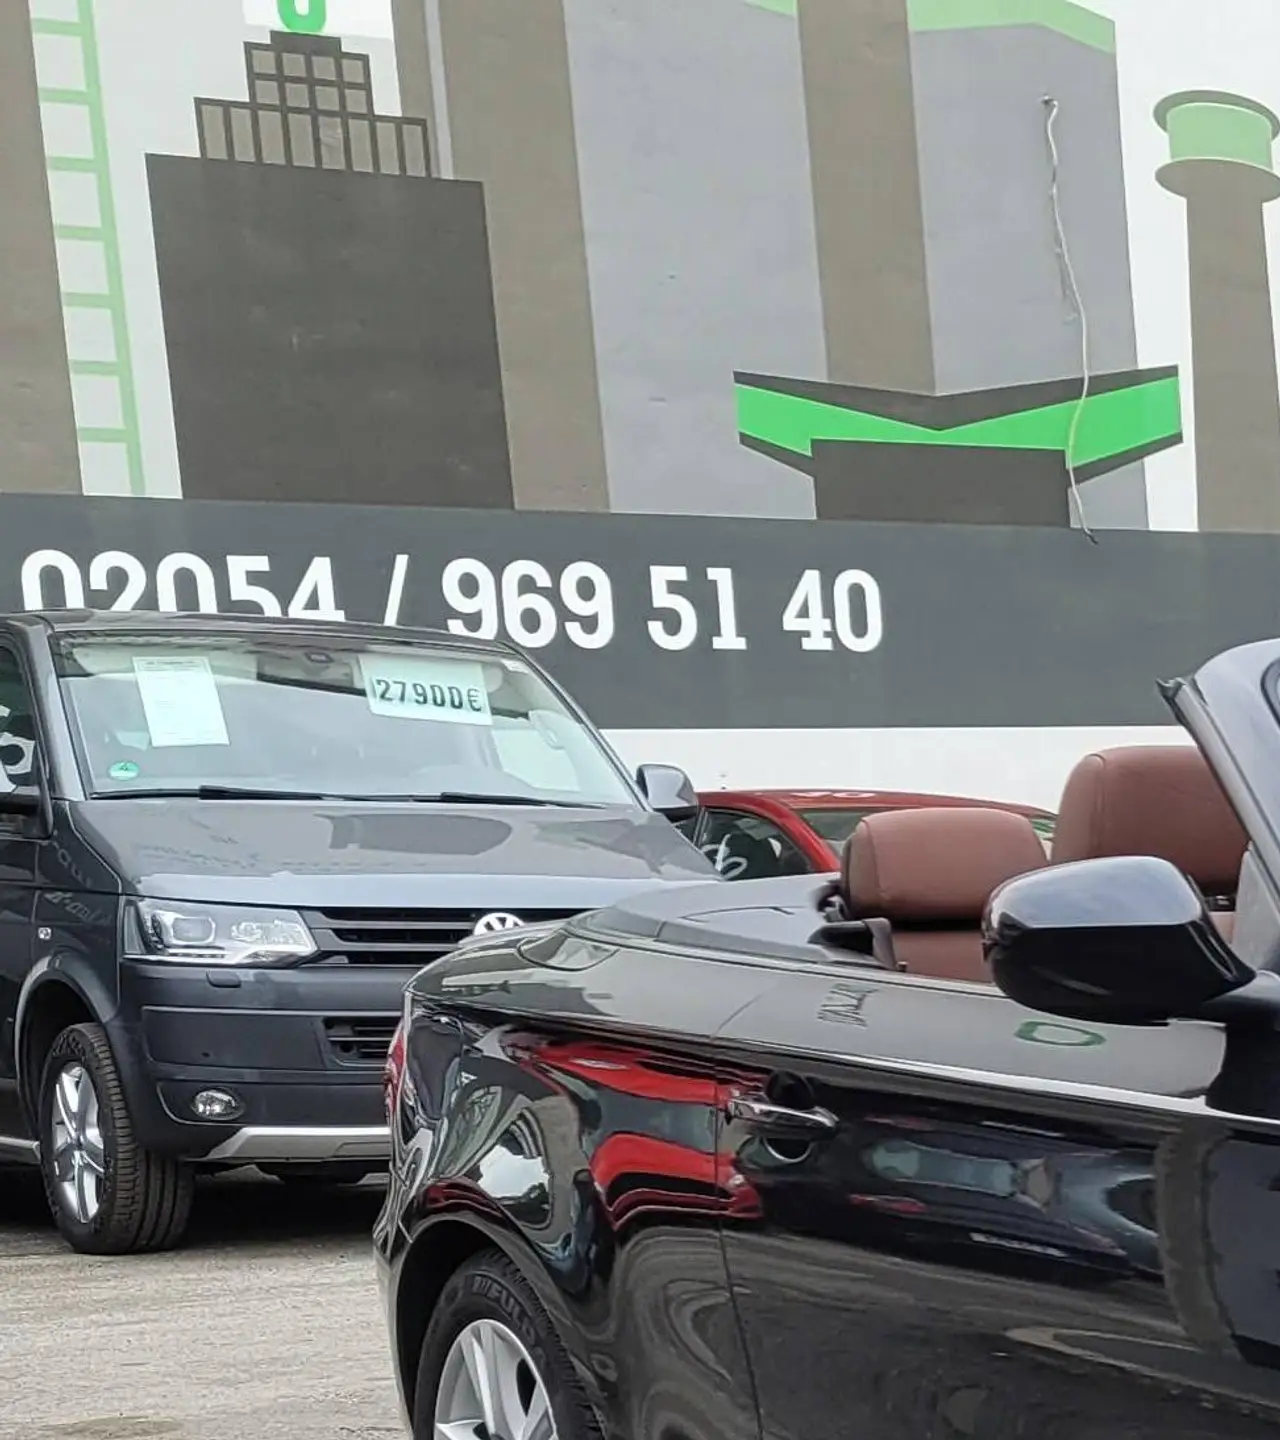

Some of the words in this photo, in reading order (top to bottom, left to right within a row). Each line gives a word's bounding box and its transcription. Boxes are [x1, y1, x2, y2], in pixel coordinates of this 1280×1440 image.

[21, 549, 346, 622] 02054
[441, 557, 615, 650] 969
[646, 565, 748, 651] 51
[782, 568, 884, 654] 40
[374, 678, 483, 713] 27900€
